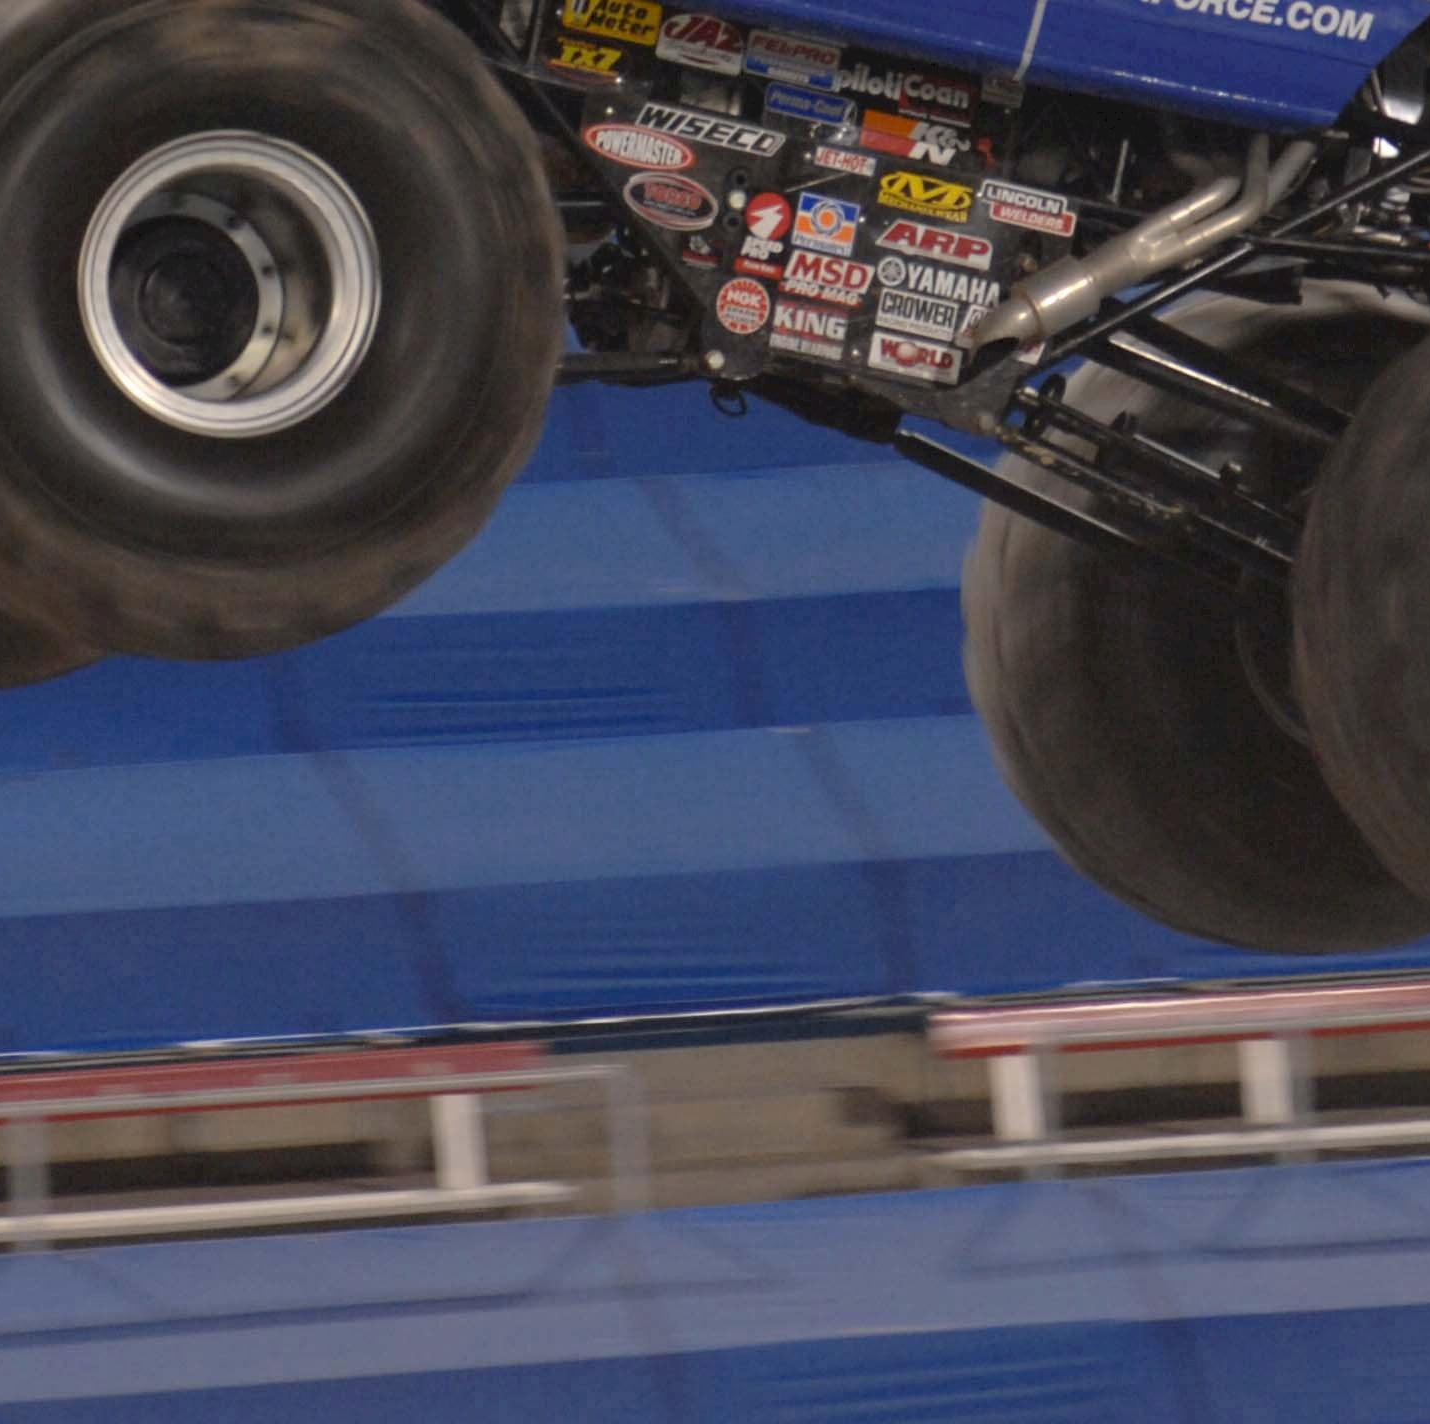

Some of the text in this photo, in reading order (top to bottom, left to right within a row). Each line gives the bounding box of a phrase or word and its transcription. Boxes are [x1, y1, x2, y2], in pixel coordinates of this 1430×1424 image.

[587, 10, 656, 36] Meter
[664, 13, 744, 55] JAZ
[904, 73, 970, 109] Coan
[637, 105, 783, 153] WISECO
[595, 129, 684, 166] POWERMASTER
[986, 186, 1061, 215] LINCOLN
[999, 206, 1065, 231] WELDERS
[884, 222, 990, 260] ARP
[792, 252, 868, 291] MSD
[907, 262, 1001, 307] YAMAHA
[774, 305, 849, 340] KING
[881, 293, 956, 327] CROWER
[881, 338, 954, 370] WORLD
